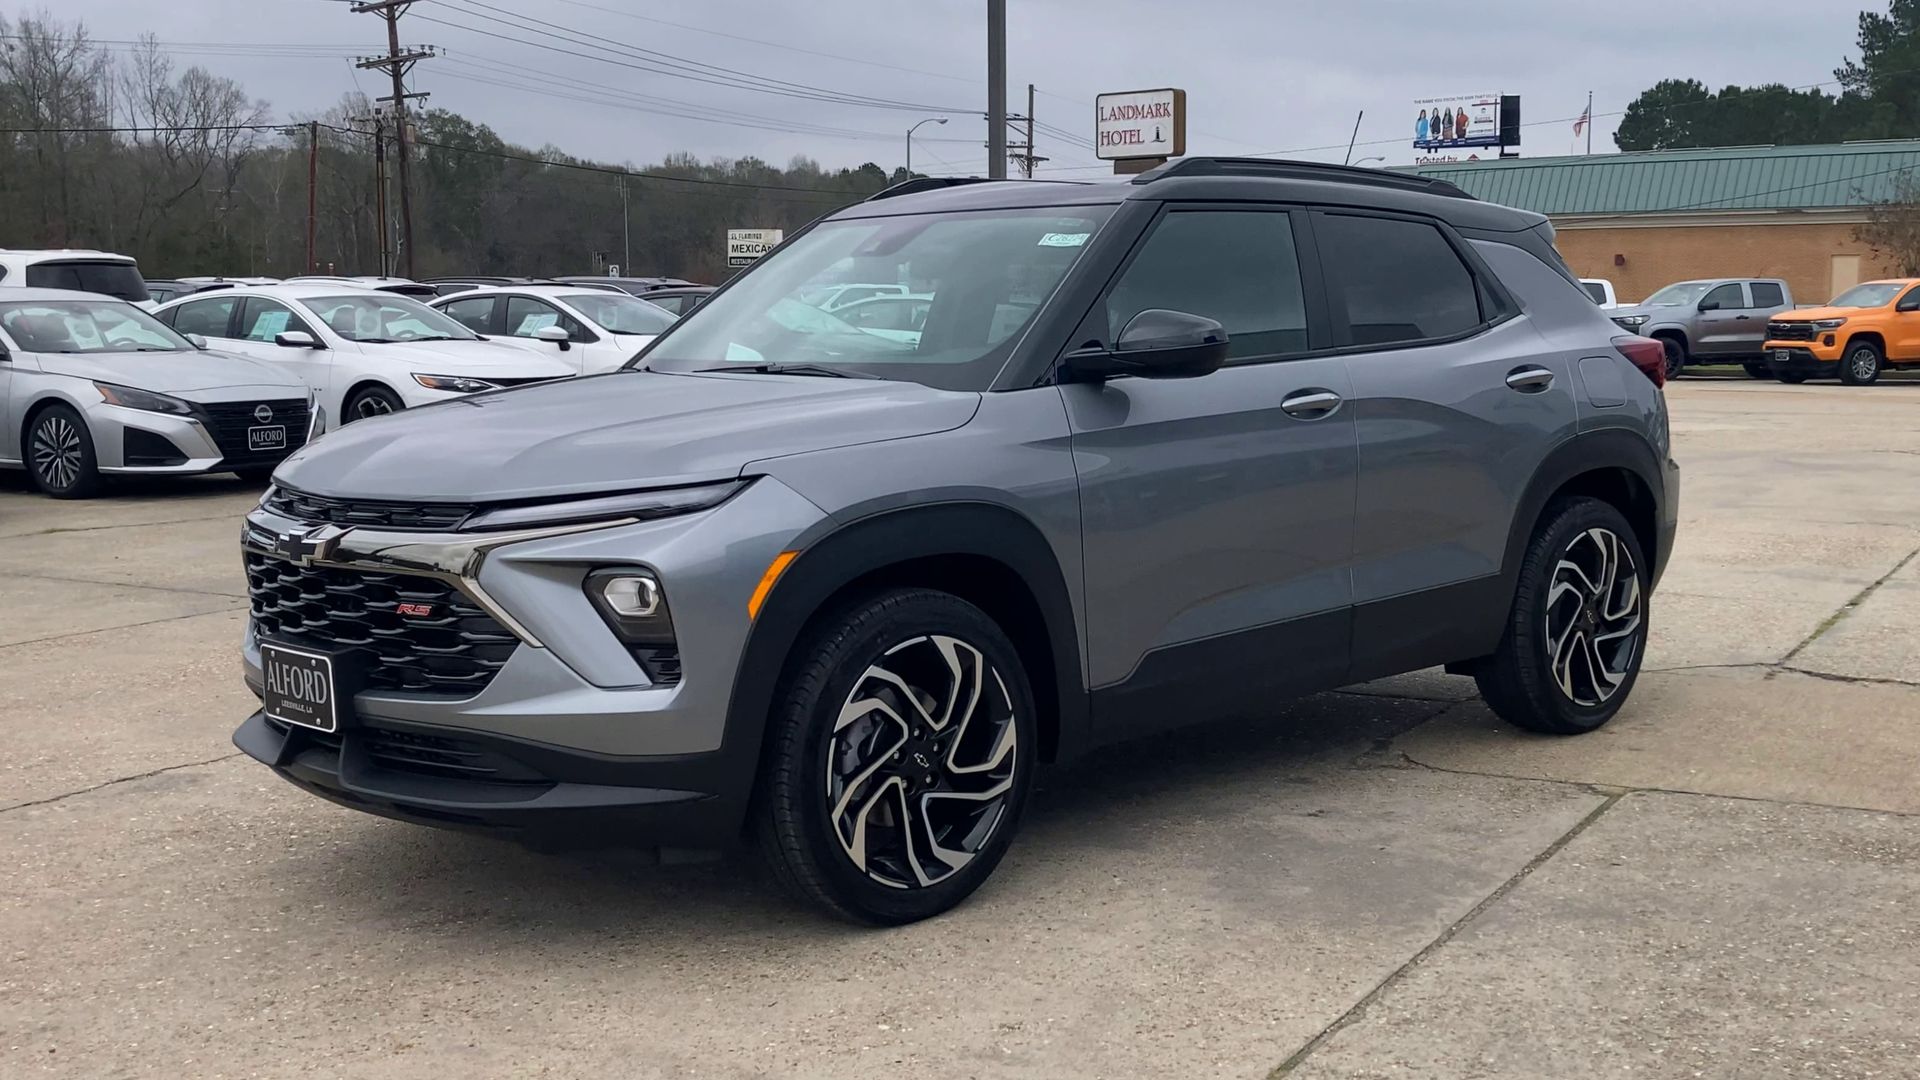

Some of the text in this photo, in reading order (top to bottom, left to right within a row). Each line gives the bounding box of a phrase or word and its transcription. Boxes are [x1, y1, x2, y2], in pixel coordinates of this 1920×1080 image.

[1100, 102, 1171, 122] LANDMARK
[1100, 129, 1145, 146] HOTEL
[252, 430, 283, 442] ALFORD
[396, 603, 432, 616] RS
[267, 660, 327, 704] ALFORD
